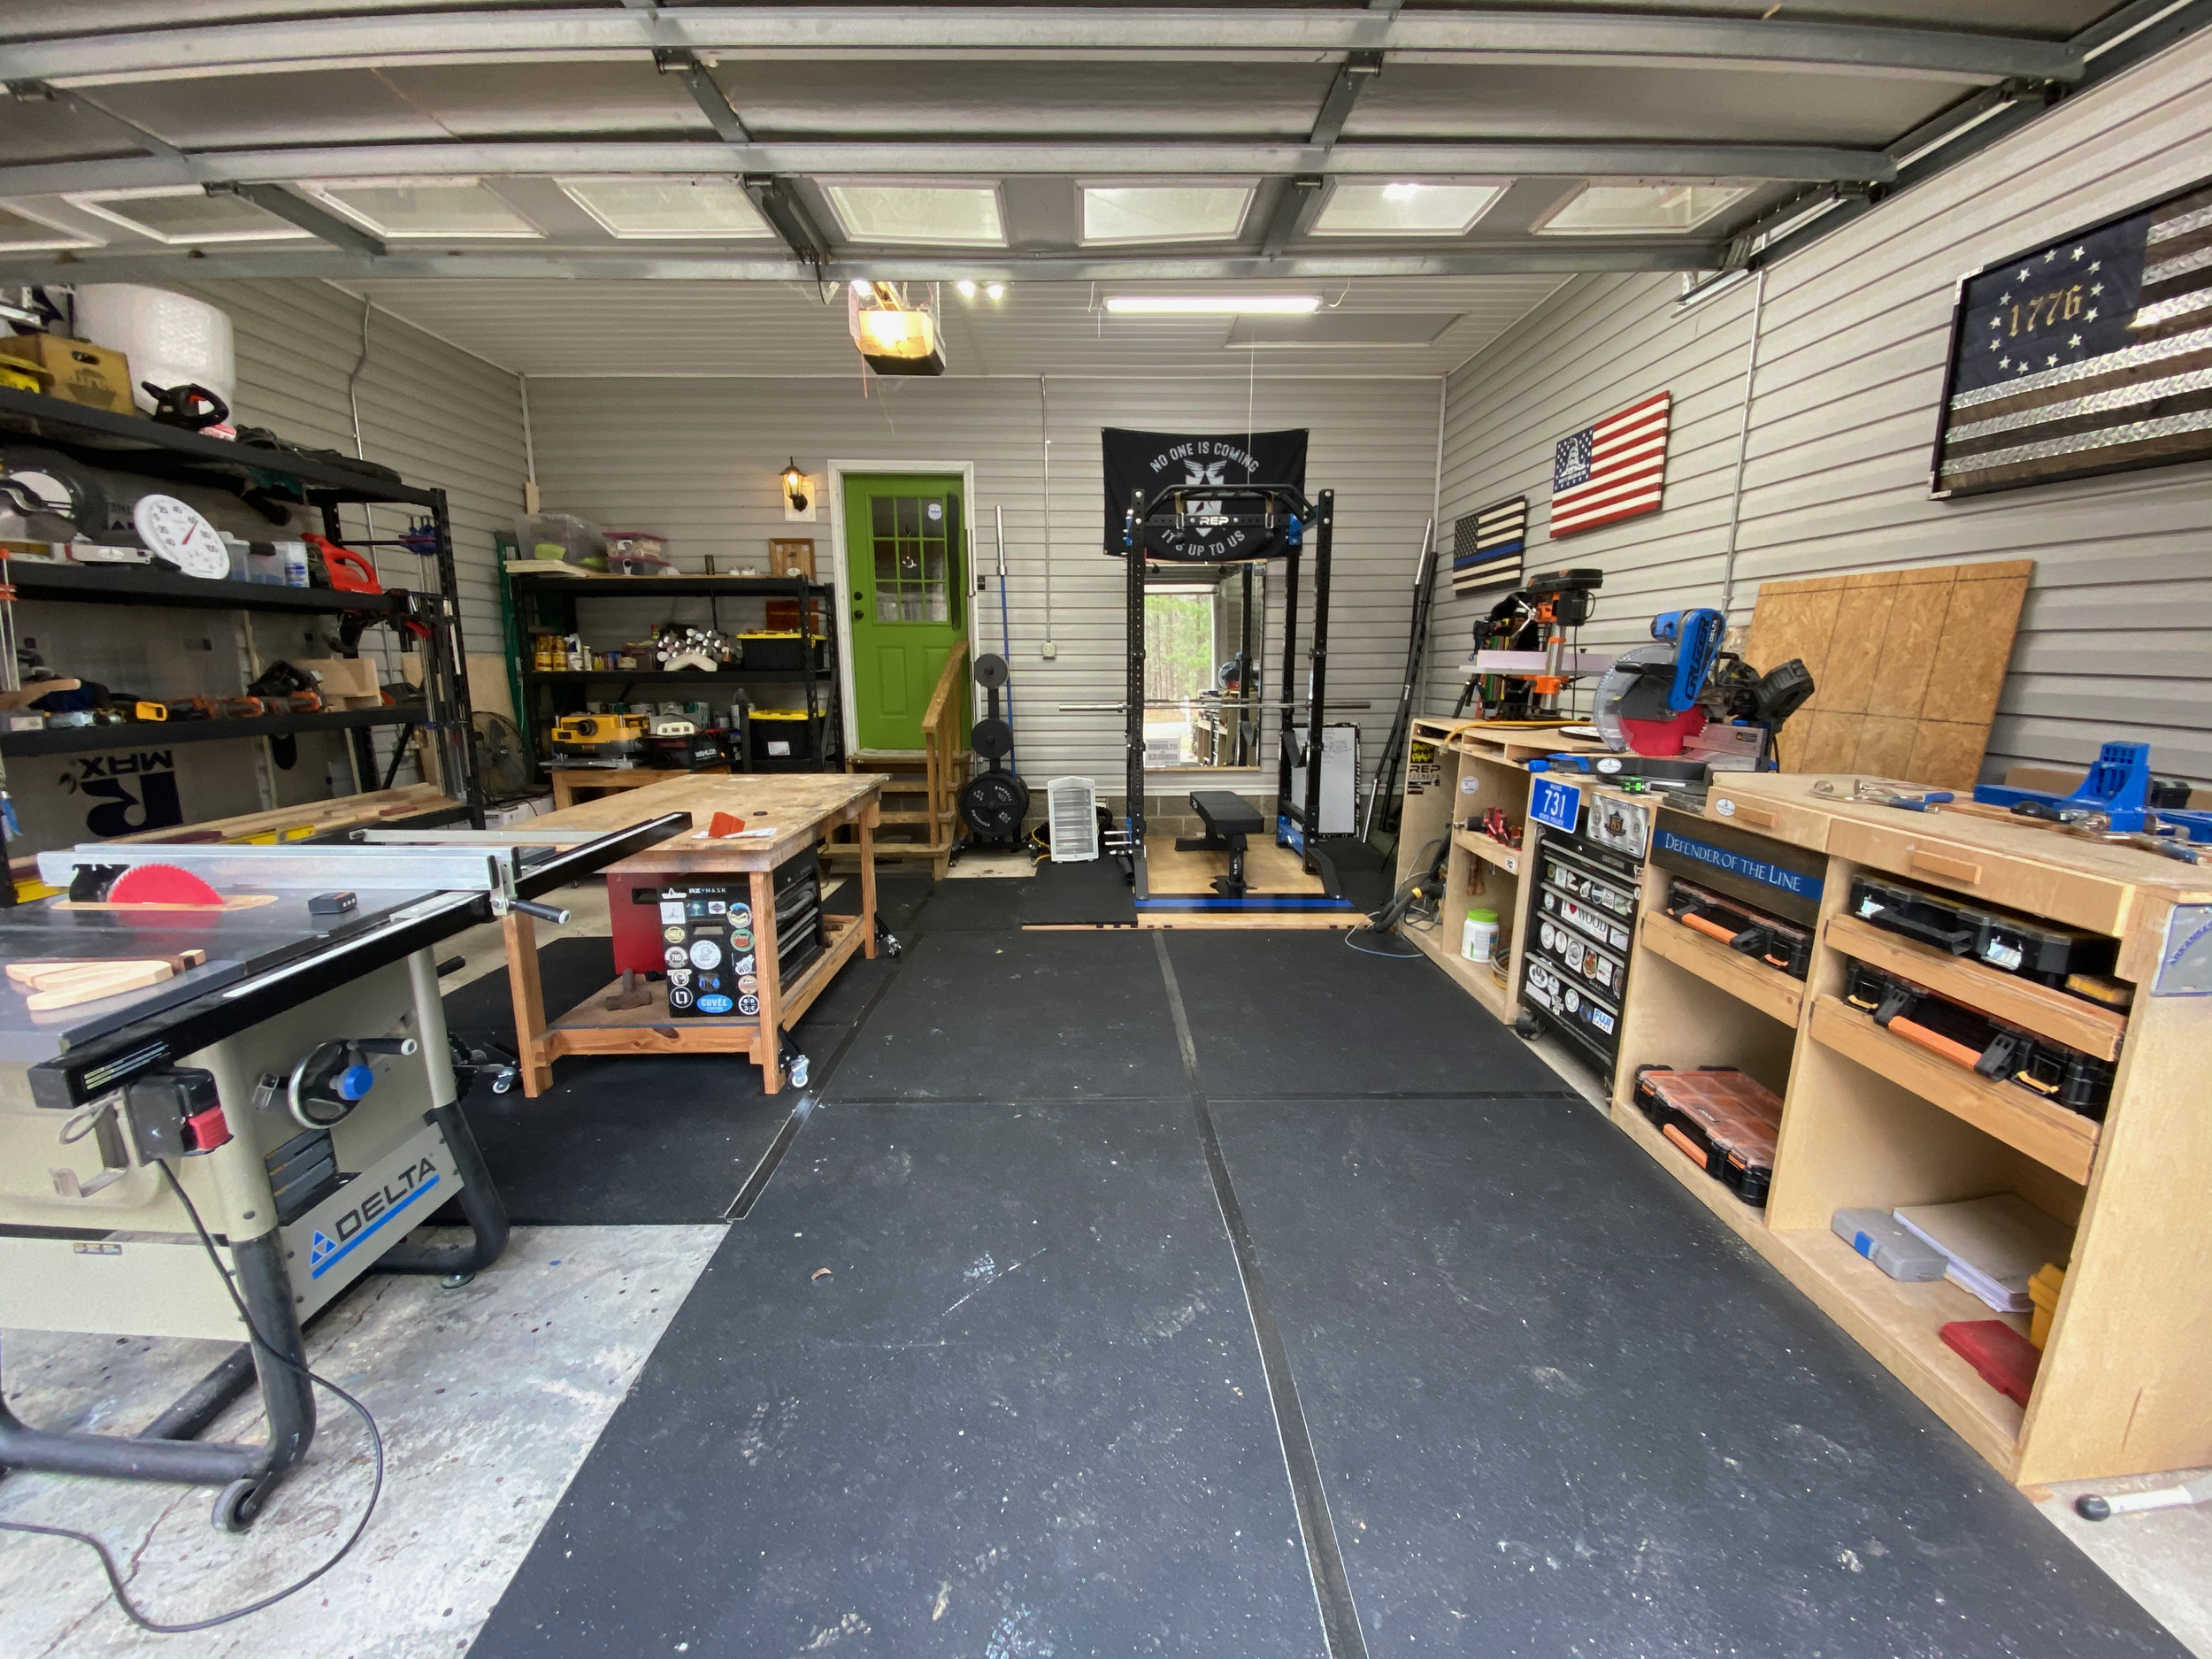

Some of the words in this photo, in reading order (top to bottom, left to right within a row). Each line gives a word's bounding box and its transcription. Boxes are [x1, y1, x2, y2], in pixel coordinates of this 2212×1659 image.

[2008, 284, 2083, 337] 1776
[1149, 454, 1169, 472] NO
[1169, 443, 1194, 460] ONE
[1197, 442, 1210, 454] IS
[1214, 442, 1259, 472] COMING
[1199, 516, 1230, 526] REP
[1161, 529, 1184, 551] ITS
[1187, 543, 1205, 557] UP
[1209, 541, 1225, 556] TO
[1226, 530, 1246, 548] US
[1709, 619, 1718, 642] DELTA
[1685, 616, 1709, 701] CRUZER
[78, 750, 174, 779] MAX
[1409, 764, 1440, 773] REP
[1543, 789, 1566, 818] 731
[1610, 817, 1622, 832] 85
[1665, 833, 1720, 865] DEFENDER
[1721, 854, 1739, 870] OF
[1740, 859, 1766, 879] THE
[1768, 865, 1801, 892] LINE
[1578, 905, 1608, 933] WOOD
[701, 996, 727, 1007] CUVÉE
[1594, 1009, 1612, 1026] FUJI
[335, 1157, 437, 1242] DELTA
